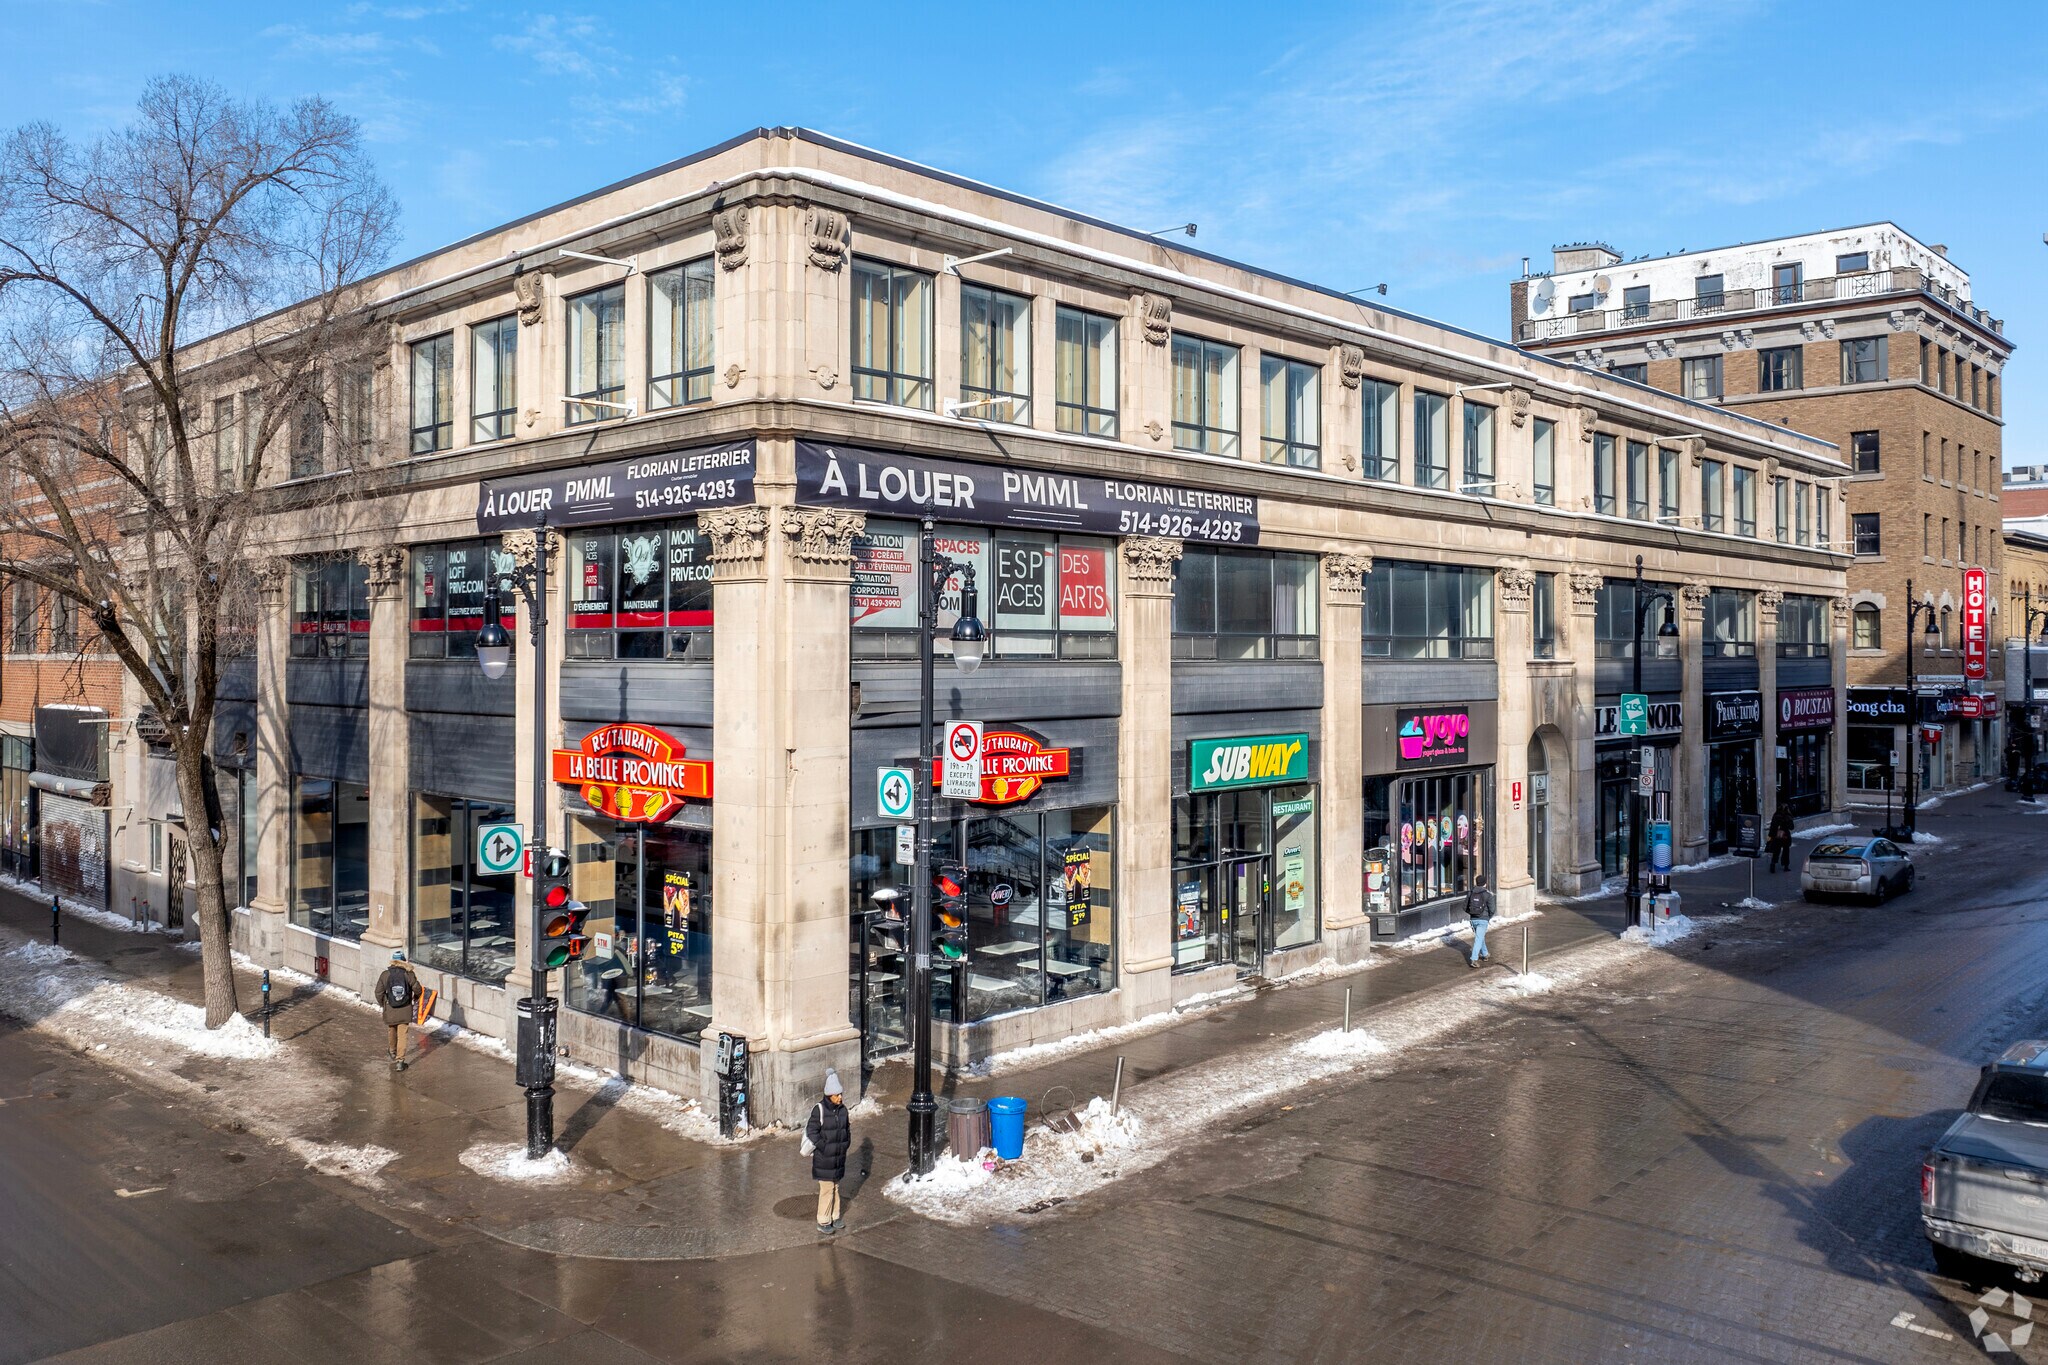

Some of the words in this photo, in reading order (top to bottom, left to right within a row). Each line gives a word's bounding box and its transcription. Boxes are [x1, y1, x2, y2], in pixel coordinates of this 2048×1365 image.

[627, 459, 679, 480] FLORIAN
[681, 449, 751, 473] LETERRIER
[819, 449, 849, 496] À
[858, 463, 975, 509] LOUER
[565, 476, 615, 503] PMML
[635, 479, 735, 509] 514-926-4293
[1003, 472, 1088, 509] PMML
[1105, 481, 1174, 505] FLORIAN
[1178, 490, 1253, 514] LETERRIER
[484, 489, 496, 518] À
[499, 487, 553, 516] LOUER
[1119, 510, 1242, 542] 514-926-4293
[671, 529, 695, 545] MON
[586, 541, 598, 552] ESP
[851, 549, 875, 559] STUDIO
[877, 550, 903, 560] CRÉATIF
[935, 538, 980, 555] SPACES
[450, 551, 467, 564] MON
[586, 552, 598, 560] ACES
[671, 548, 694, 564] LOFT
[1000, 548, 1043, 579] ESP
[1062, 553, 1090, 575] DES
[449, 566, 466, 580] LOFT
[585, 574, 598, 585] ARTS
[449, 580, 484, 594] PRIVE.COM
[851, 585, 899, 597] CORPORATIVE
[998, 583, 1043, 607] ACES
[623, 600, 659, 610] MAINTENANT
[851, 597, 869, 608] (514)
[870, 598, 901, 608] 439-3990
[940, 597, 960, 610] OM
[1061, 585, 1105, 609] ARTS
[1968, 576, 1982, 656] HÔTEL
[1626, 703, 1642, 711] CLSC
[1716, 700, 1737, 727] PRANA
[1794, 697, 1832, 715] BOUSTAN
[1880, 700, 1906, 714] cha
[1595, 707, 1618, 735] LE
[1423, 714, 1469, 748] yoyo
[592, 729, 659, 758] RESTAURANT
[981, 737, 1034, 754] ESTAURANT
[950, 762, 960, 770] 19h
[966, 762, 974, 771] 7h
[981, 759, 999, 775] LLE
[1003, 755, 1053, 774] PROVINCE
[1203, 739, 1302, 785] SUBWAY
[570, 756, 583, 778] LA
[586, 757, 618, 782] BELLE
[623, 760, 685, 788] PROVINCE
[949, 771, 973, 780] EXCEPTÉ
[946, 779, 976, 787] LIVRAISON
[950, 788, 971, 796] LOCALE
[1272, 802, 1312, 815] RESTAURANT
[1066, 852, 1089, 863] SPÉCIAL
[665, 873, 689, 887] SPÉCIAL
[1069, 903, 1087, 912] PITA
[668, 930, 685, 940] PITA
